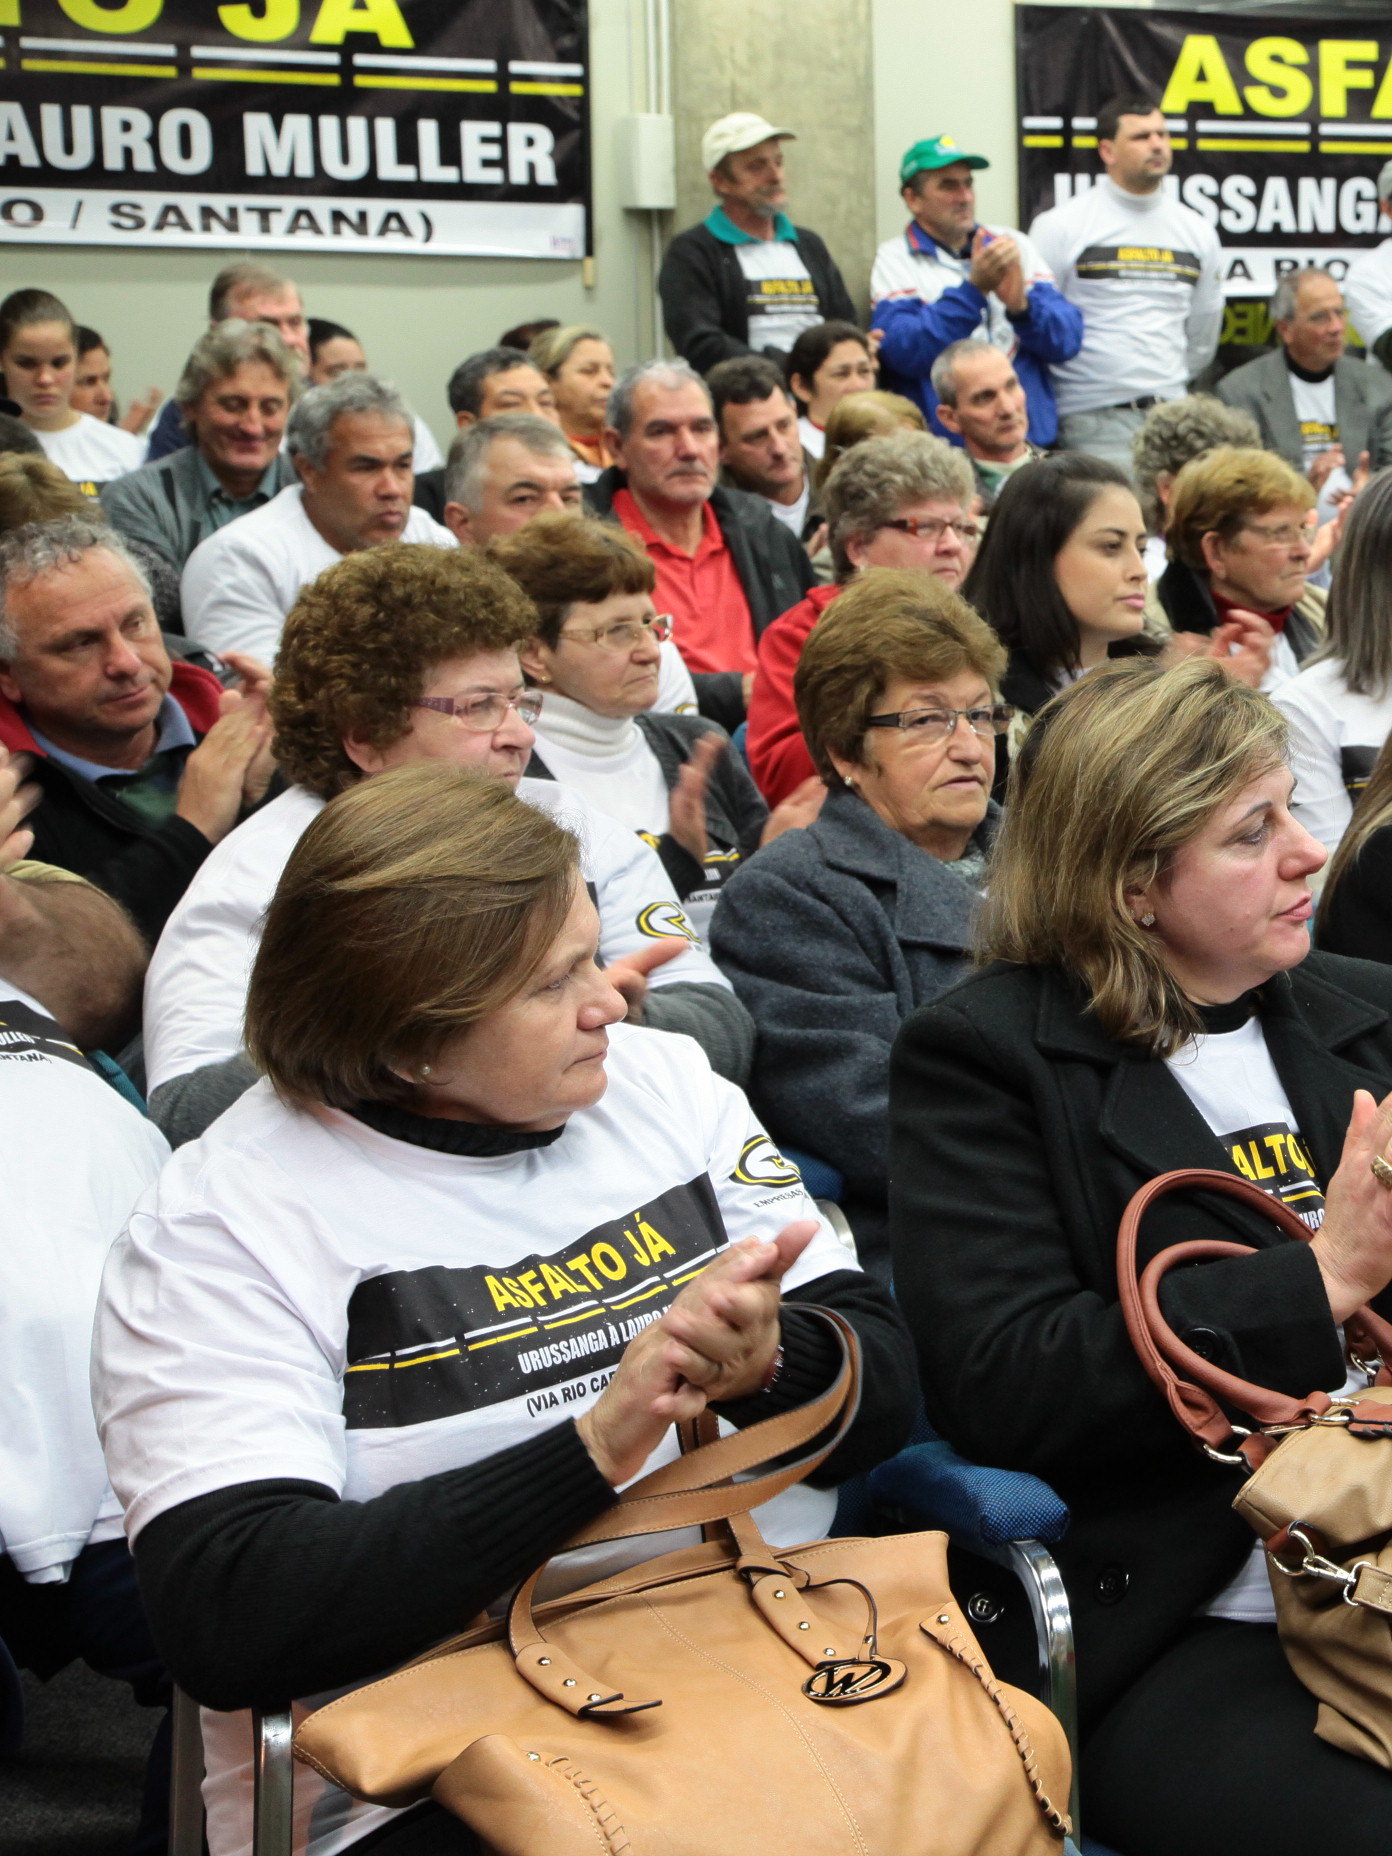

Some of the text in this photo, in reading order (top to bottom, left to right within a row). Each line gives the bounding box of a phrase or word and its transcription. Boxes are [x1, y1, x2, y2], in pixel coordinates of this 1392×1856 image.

[243, 112, 559, 186] MULLER
[108, 202, 433, 244] SANTANA)
[484, 1211, 677, 1313] ASFALTO JÁ
[517, 1328, 609, 1375] URUSSANGA
[526, 1391, 561, 1418] (VIA
[560, 1381, 587, 1403] RIO
